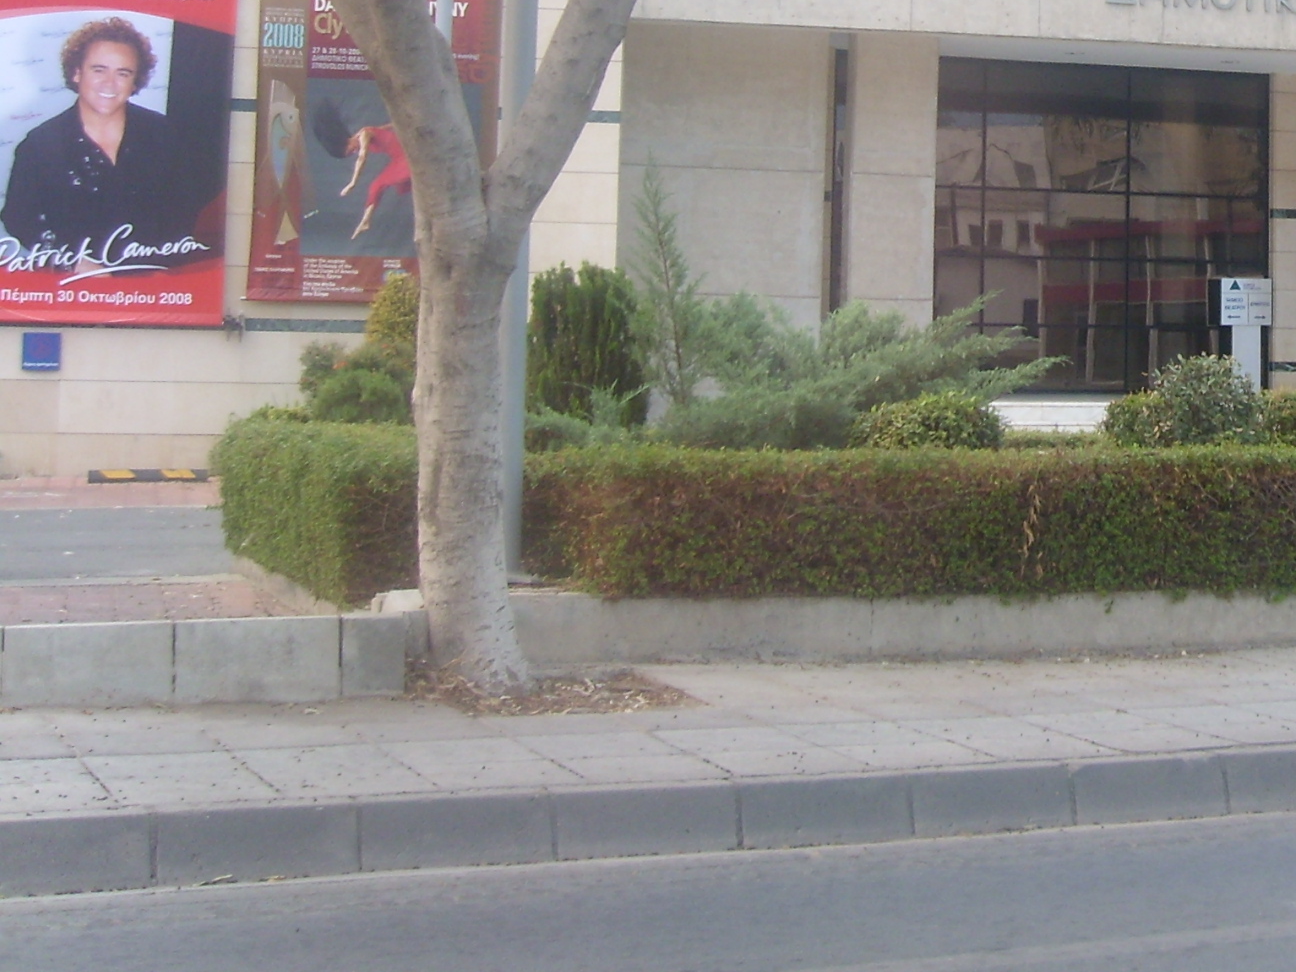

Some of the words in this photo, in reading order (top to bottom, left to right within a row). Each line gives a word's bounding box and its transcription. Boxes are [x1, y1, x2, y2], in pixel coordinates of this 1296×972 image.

[263, 22, 305, 49] 2008
[0, 236, 103, 272] Patrick
[103, 223, 211, 267] Cameron
[0, 288, 54, 304] Πέμπτη
[57, 290, 74, 302] 30
[78, 290, 156, 306] Οκτωβρίου
[159, 292, 193, 305] 2008
